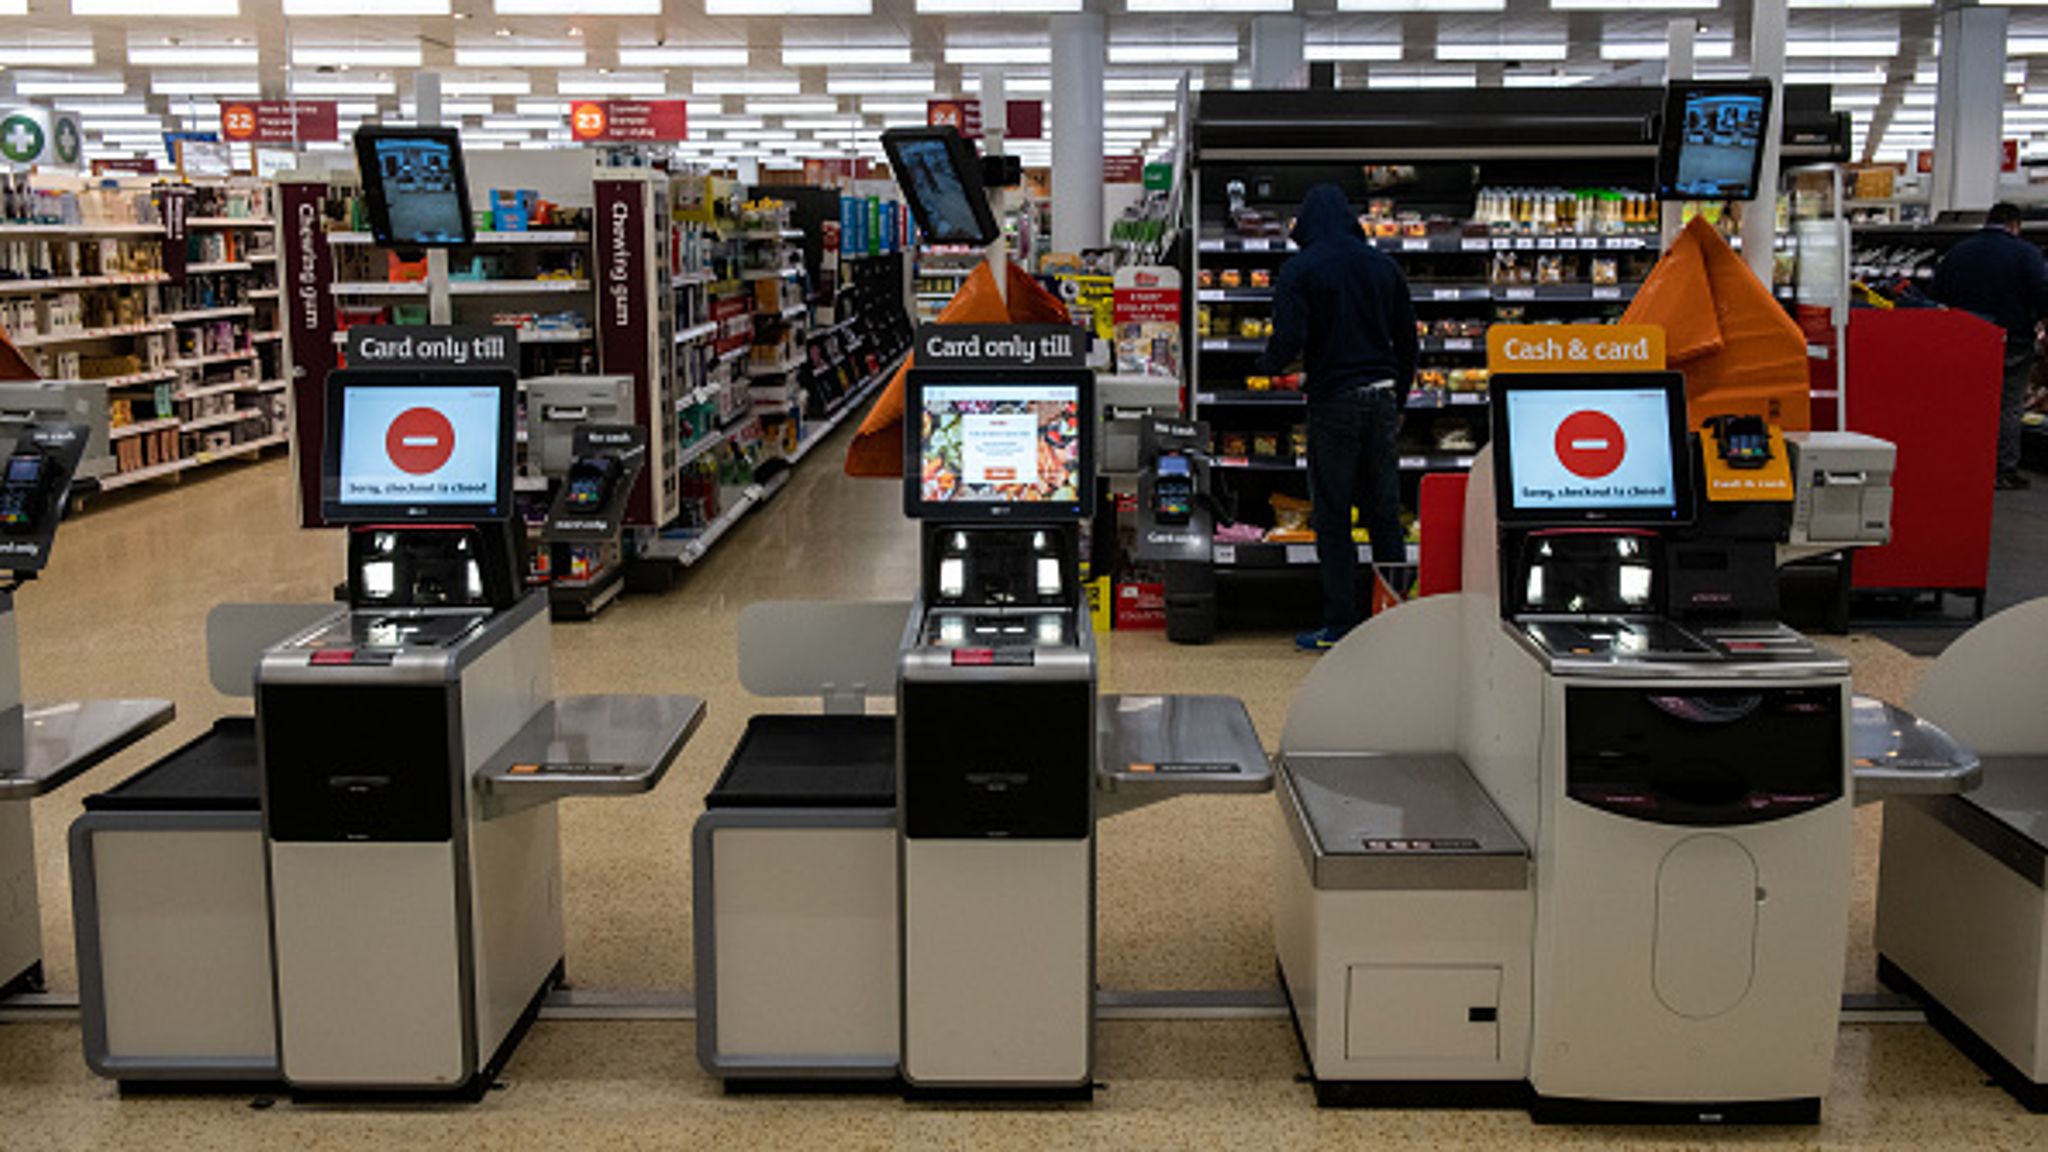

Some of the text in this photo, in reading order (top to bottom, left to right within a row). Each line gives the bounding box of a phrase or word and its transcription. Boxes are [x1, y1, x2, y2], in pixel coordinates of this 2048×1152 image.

[227, 113, 253, 129] 22
[577, 113, 602, 129] 23
[299, 203, 318, 329] Chewing gum
[609, 202, 631, 326] Chewing gum
[359, 336, 505, 364] Card only till
[926, 335, 1073, 363] Card only till
[1503, 337, 1649, 361] Cash & card
